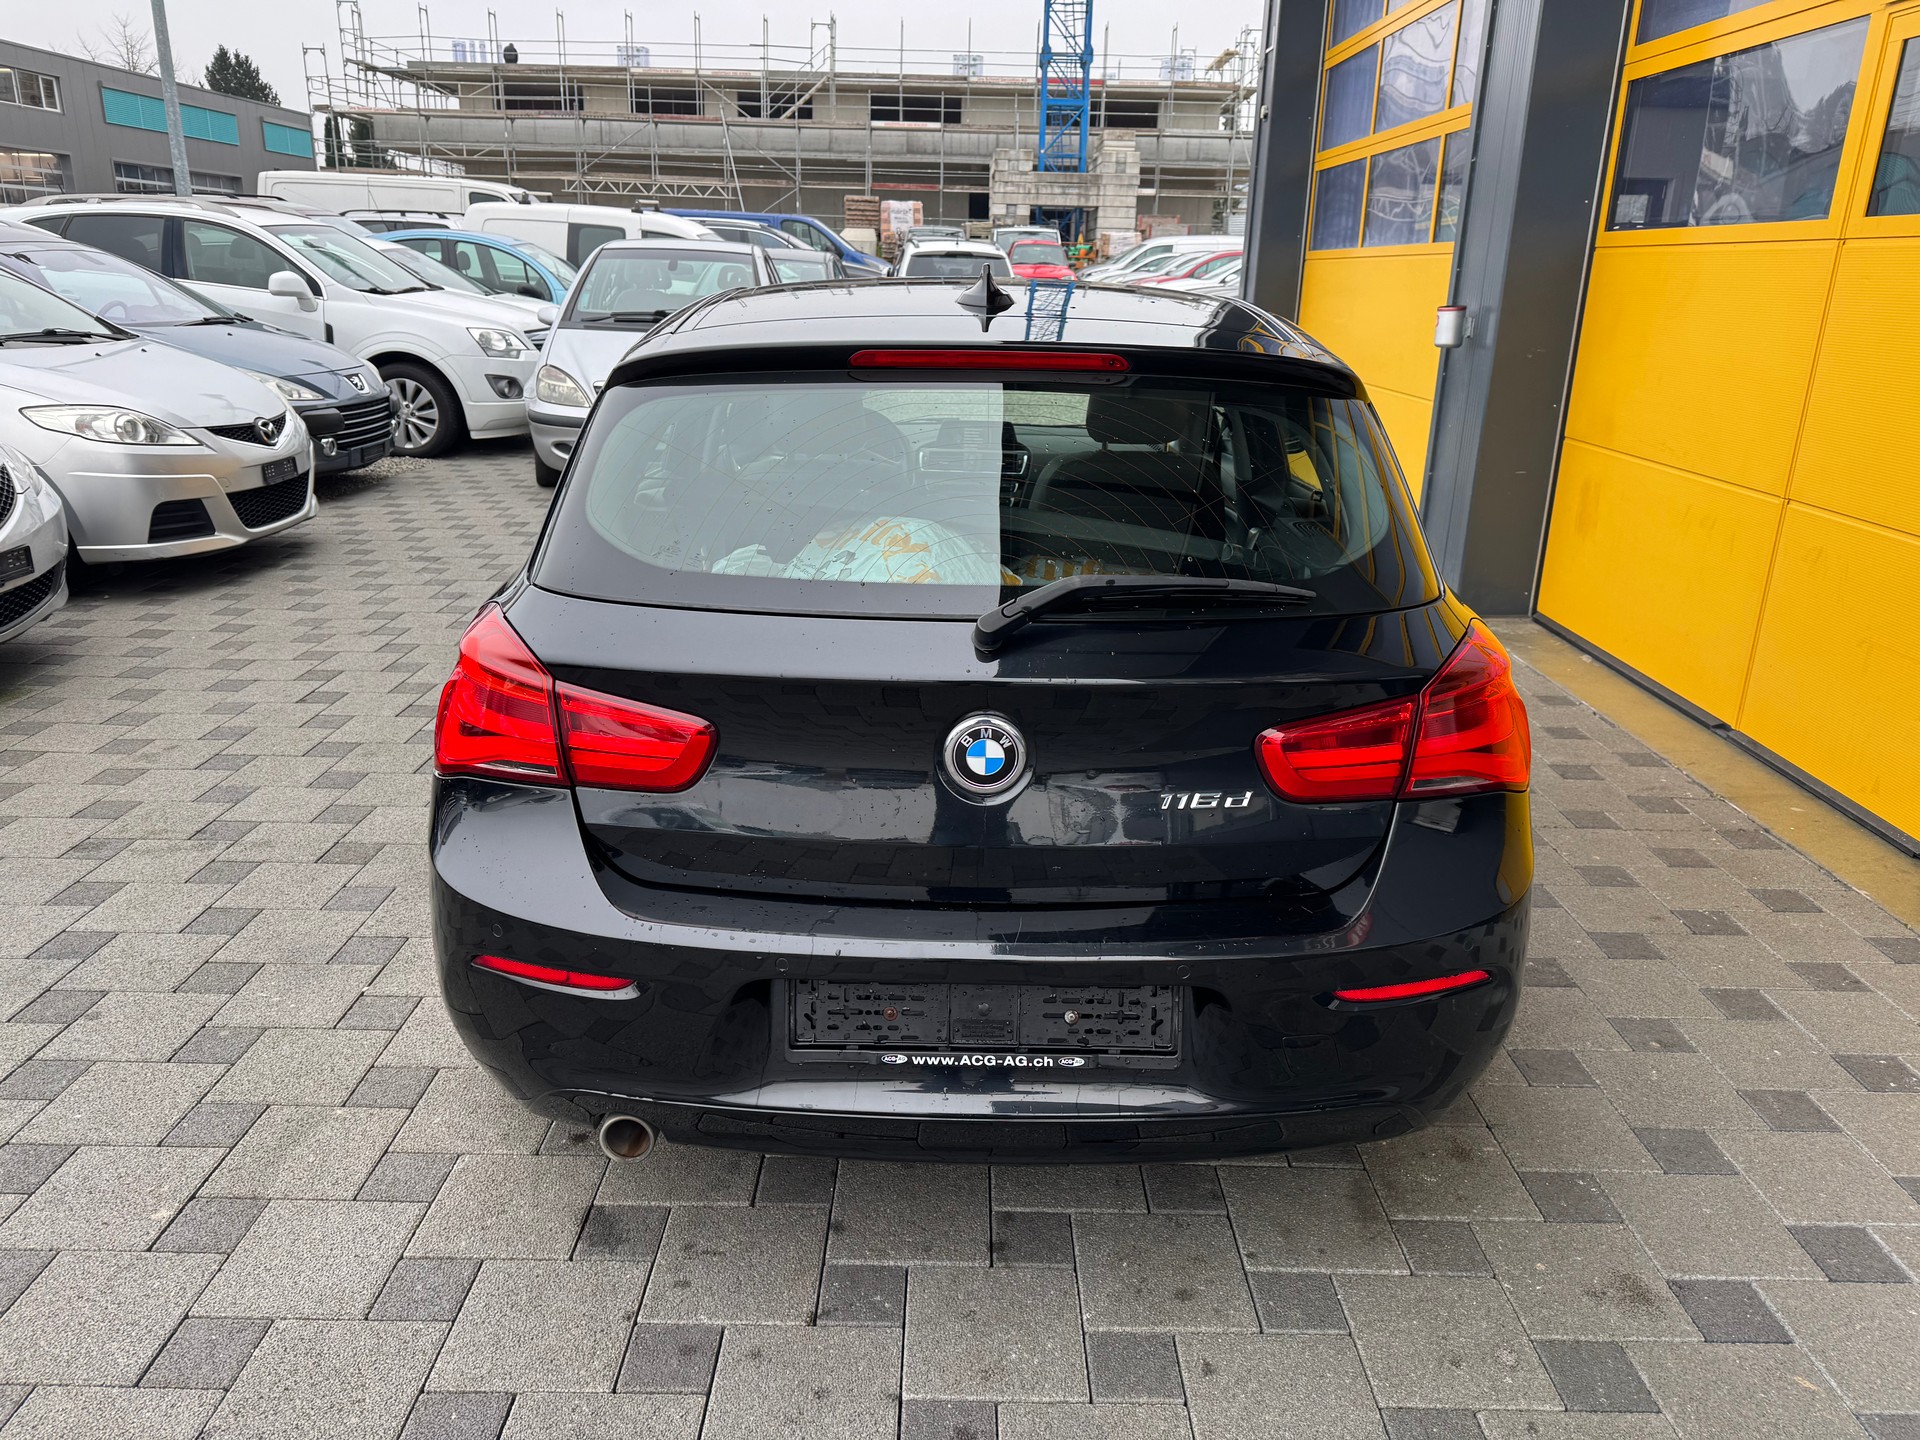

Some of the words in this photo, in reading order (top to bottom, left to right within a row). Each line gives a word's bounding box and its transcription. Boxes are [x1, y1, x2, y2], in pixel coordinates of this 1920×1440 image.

[960, 728, 1012, 749] BMW
[1161, 791, 1254, 810] 116d
[912, 1055, 1053, 1067] www.ACG-AG.ch
